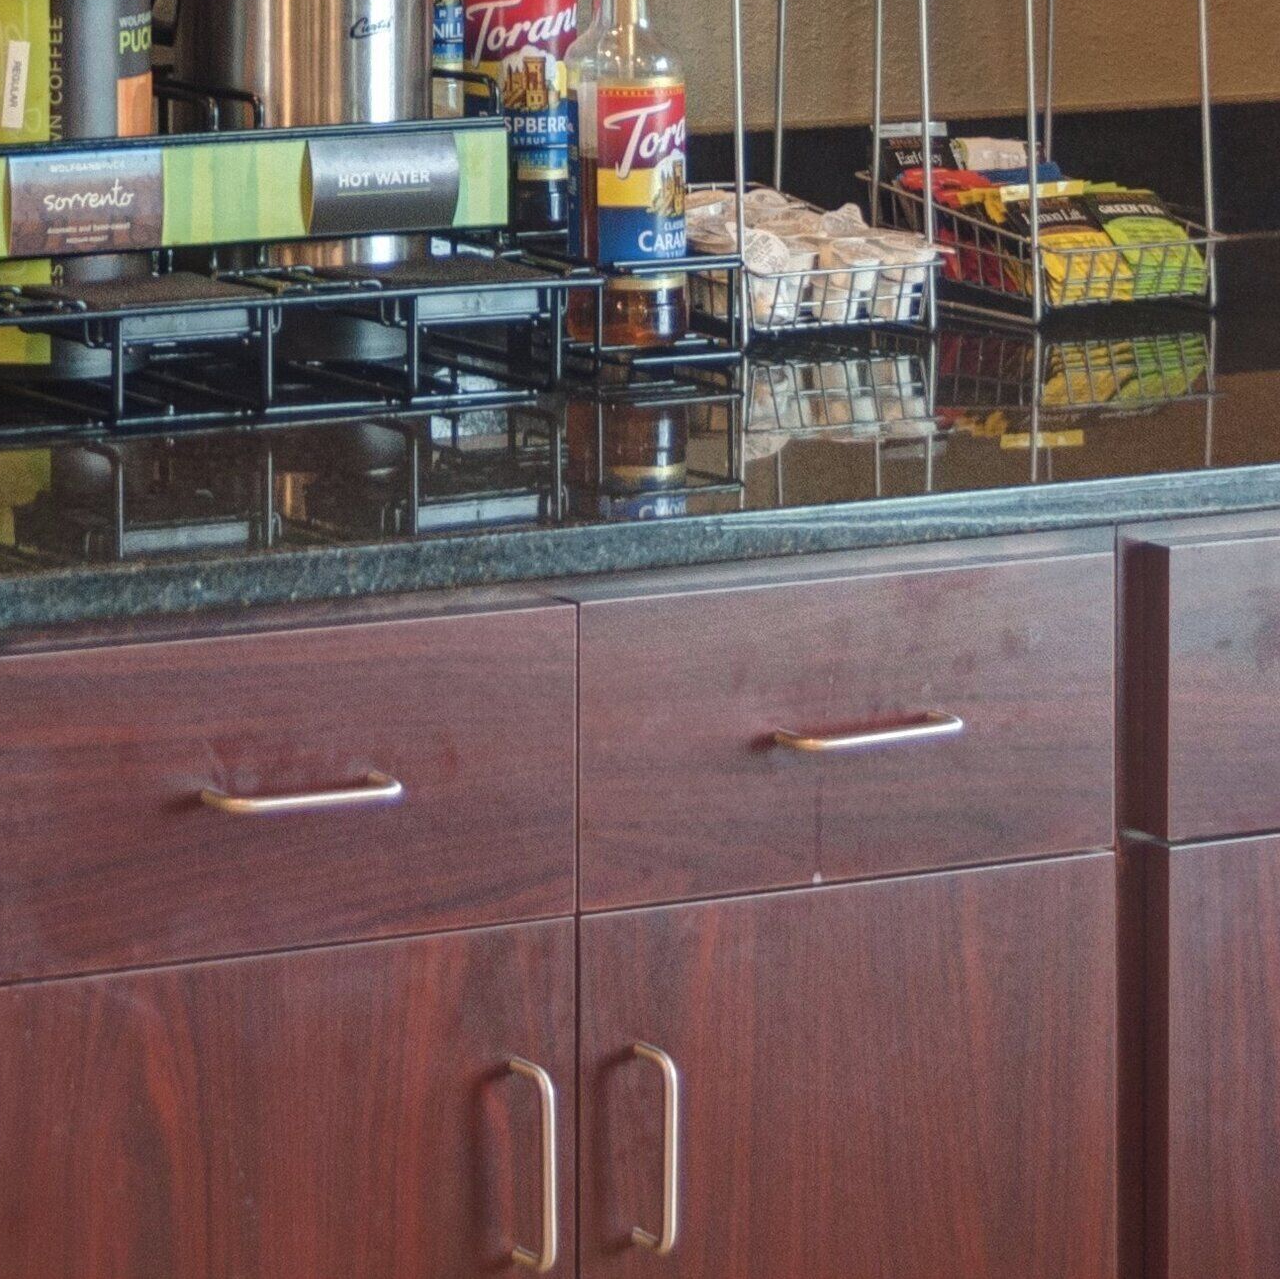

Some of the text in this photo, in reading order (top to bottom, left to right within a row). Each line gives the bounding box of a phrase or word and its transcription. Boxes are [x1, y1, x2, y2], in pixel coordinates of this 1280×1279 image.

[119, 26, 152, 55] PUC
[50, 18, 63, 105] COFFEE
[9, 61, 21, 109] REGULAR
[603, 98, 686, 180] Tora
[338, 168, 431, 189] HOT WATER
[1098, 203, 1164, 216] GREEN TEA
